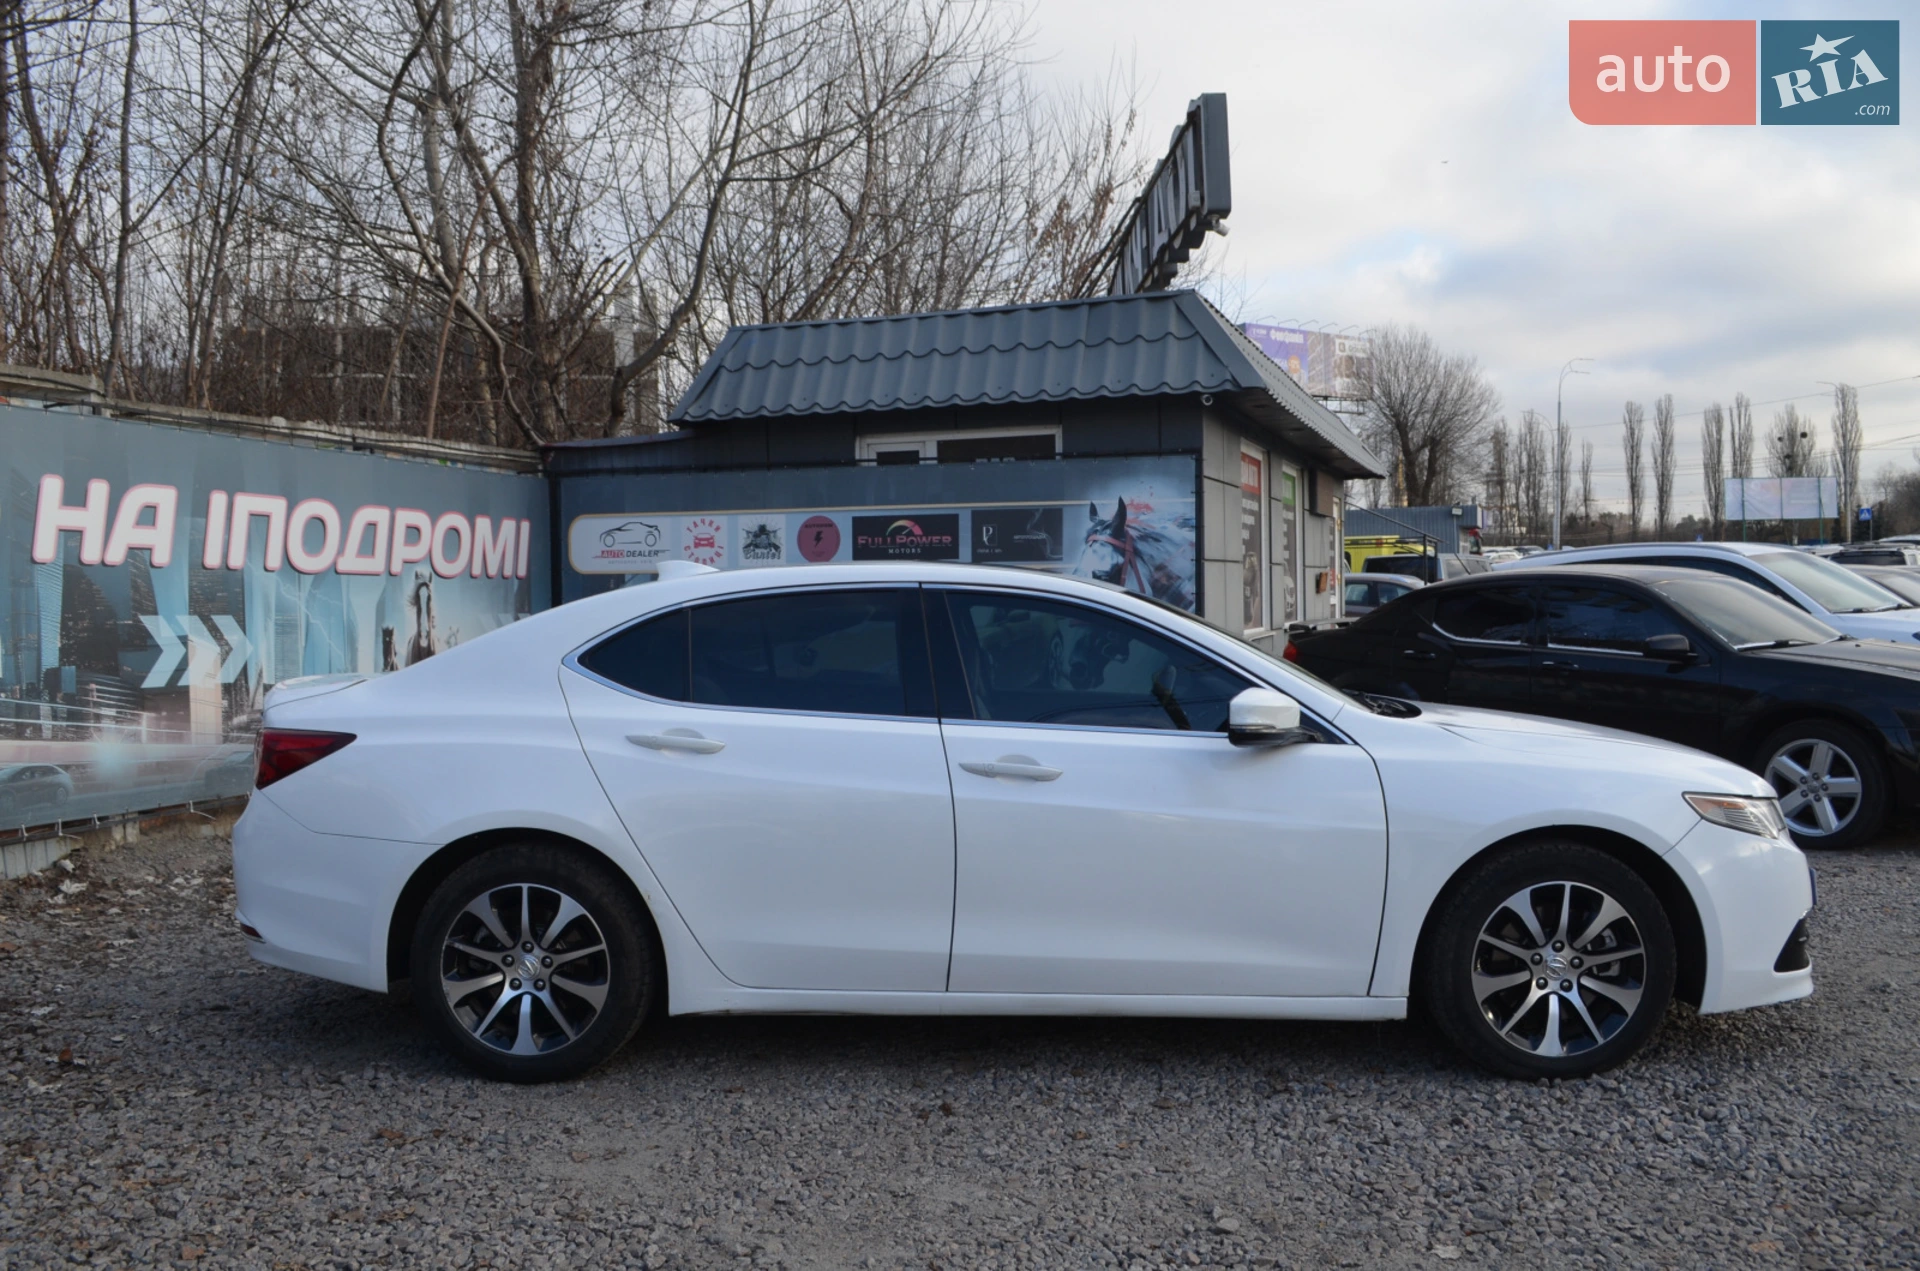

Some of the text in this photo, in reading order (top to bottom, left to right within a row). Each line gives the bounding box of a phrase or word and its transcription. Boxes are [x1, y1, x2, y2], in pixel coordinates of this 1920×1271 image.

[32, 473, 530, 579] НА ІПОДРОМІ
[601, 550, 660, 558] AUTO DEALER
